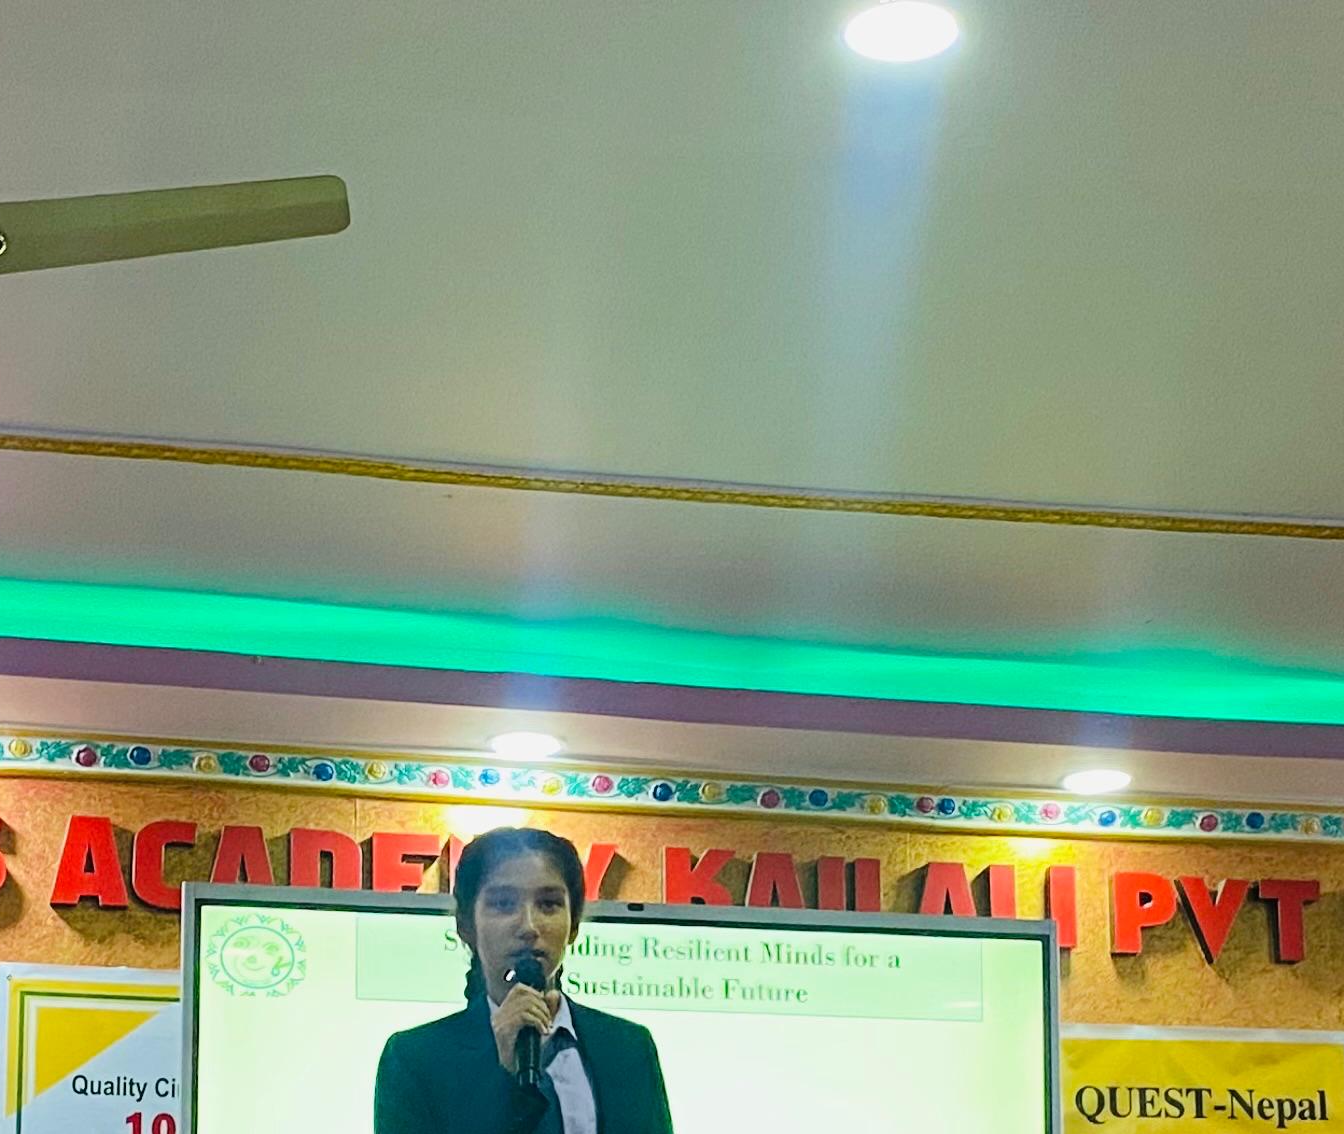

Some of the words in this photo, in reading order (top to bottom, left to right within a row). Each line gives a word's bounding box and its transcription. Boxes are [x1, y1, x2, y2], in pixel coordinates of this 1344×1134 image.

[49, 814, 619, 910] ACADE
[1110, 871, 1320, 964] PVT
[641, 936, 752, 963] Resilient
[760, 940, 836, 967] Minds
[844, 945, 879, 968] for
[887, 952, 902, 969] a
[567, 972, 714, 1000] Sustainable
[722, 978, 809, 1004] Future
[72, 1075, 147, 1102] Quality
[1075, 1085, 1329, 1129] QUEST-Nepal
